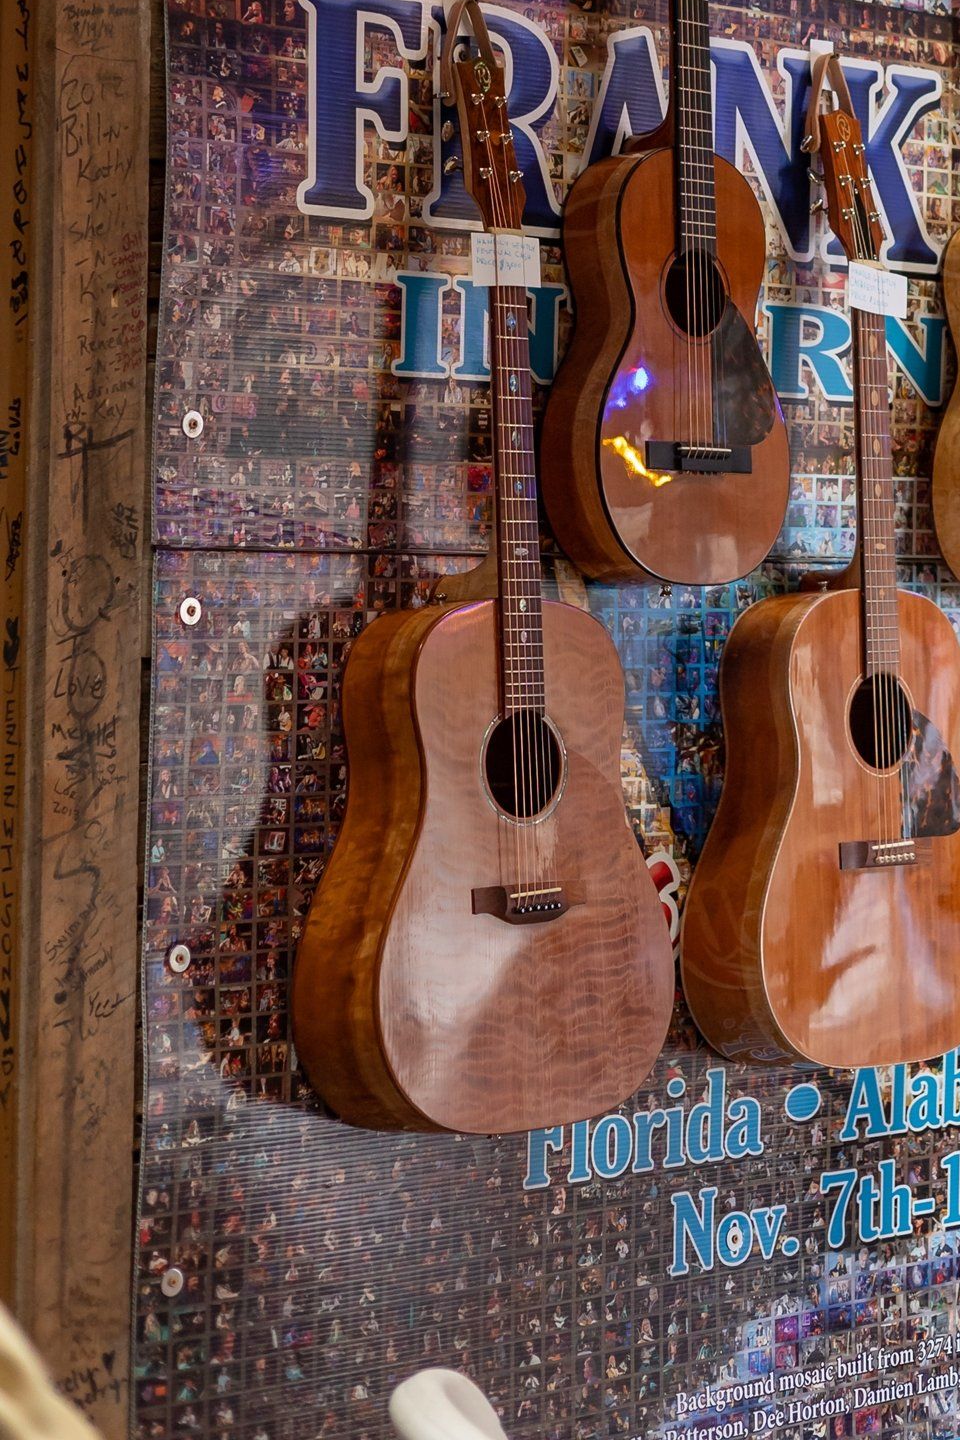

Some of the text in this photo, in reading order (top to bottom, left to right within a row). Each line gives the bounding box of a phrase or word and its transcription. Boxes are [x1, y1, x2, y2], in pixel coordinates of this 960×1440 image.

[53, 667, 106, 700] Love
[523, 1067, 763, 1190] Florida
[669, 1186, 800, 1277] Nov.
[675, 1371, 775, 1414] Background
[778, 1364, 834, 1392] mosaic
[836, 1352, 875, 1382] built
[876, 1348, 914, 1372] from
[917, 1335, 953, 1360] 3274
[753, 1409, 784, 1432] Dee
[788, 1396, 850, 1425] Horton,
[853, 1383, 914, 1409] Damien
